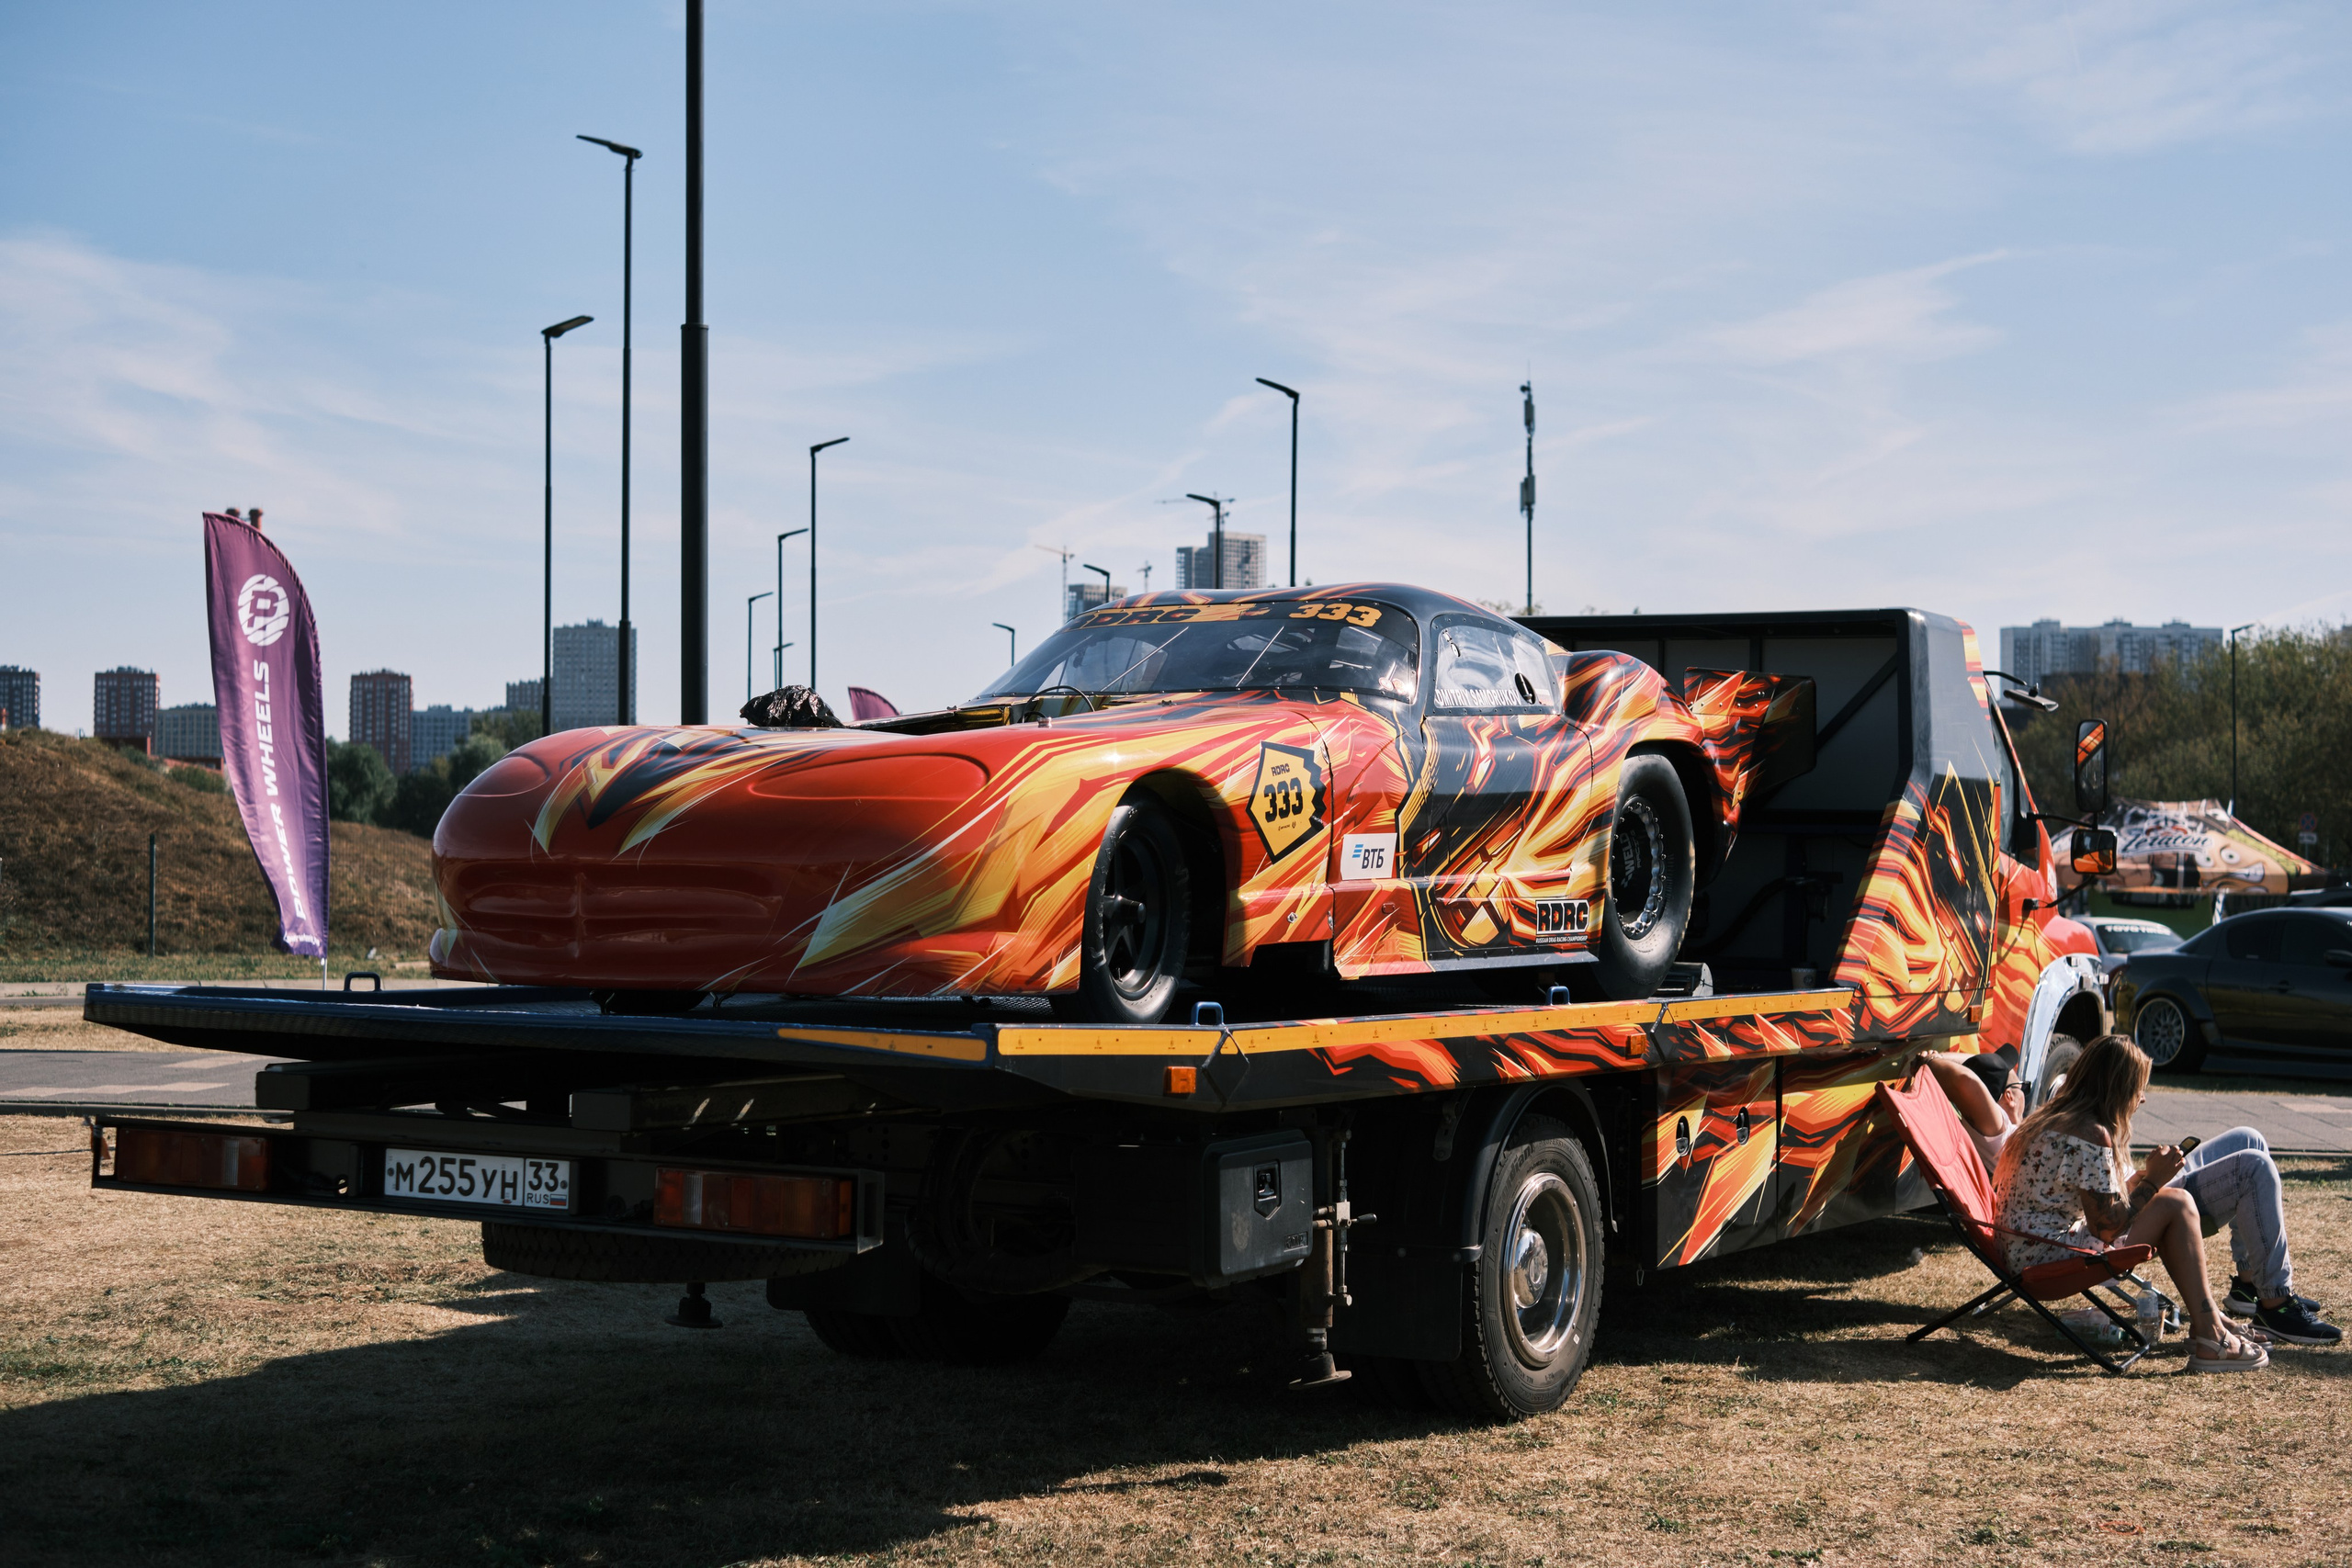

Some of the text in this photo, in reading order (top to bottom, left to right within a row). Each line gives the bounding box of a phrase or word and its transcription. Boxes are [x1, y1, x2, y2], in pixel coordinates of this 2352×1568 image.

[1288, 603, 1383, 627] 333
[1434, 689, 1522, 707] DMITRIY SAMORUKOV
[253, 659, 278, 797] WHEELS
[1271, 763, 1291, 776] RDRC
[1263, 777, 1304, 823] 333
[270, 804, 307, 921] POWER
[1362, 848, 1385, 869] ВТБ
[1620, 832, 1634, 875] WELD
[1537, 902, 1588, 931] RDRC
[528, 1161, 560, 1192] 33
[526, 1193, 549, 1204] RUS
